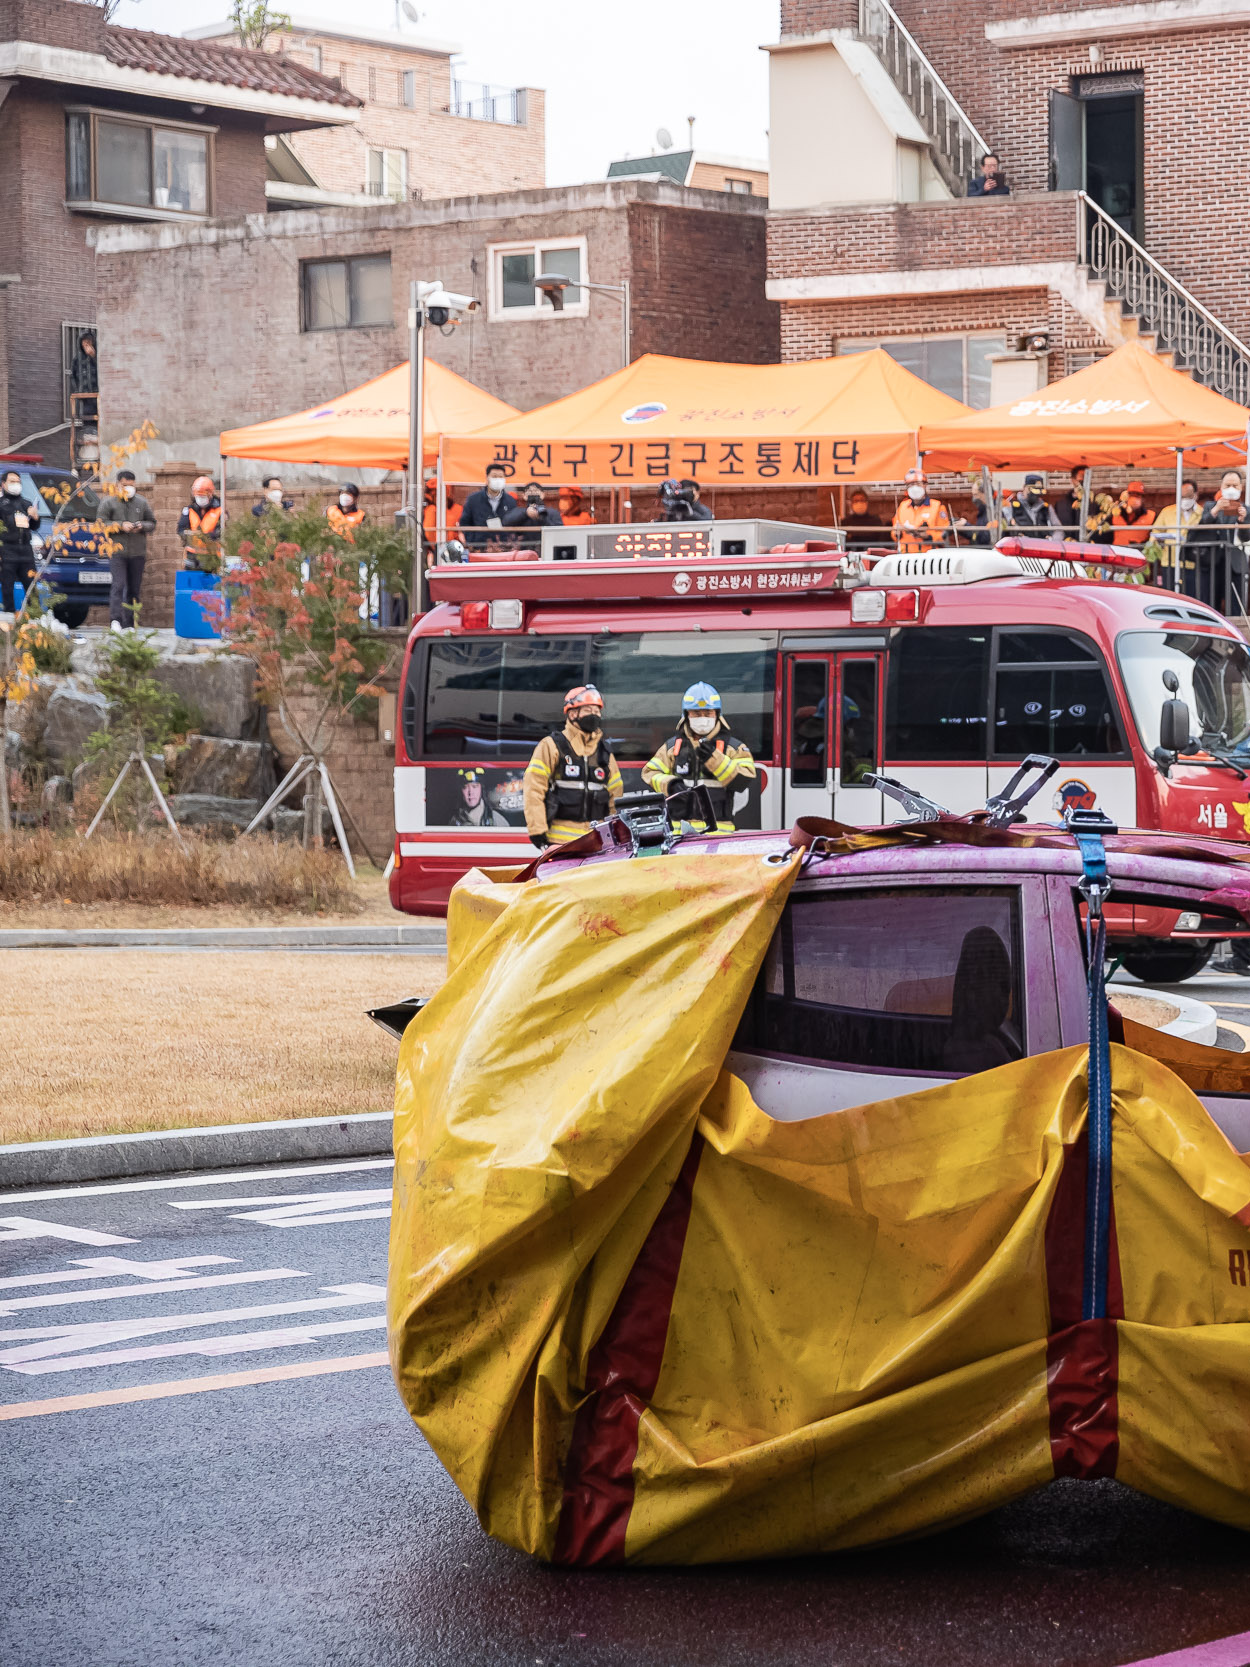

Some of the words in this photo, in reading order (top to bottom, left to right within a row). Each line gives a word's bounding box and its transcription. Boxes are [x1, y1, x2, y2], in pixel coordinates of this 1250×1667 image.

[492, 443, 588, 478] 광진구
[609, 440, 860, 478] 긴급구조통제단
[696, 574, 753, 591] 광진소방서
[756, 572, 824, 589] 현장지휘본부
[1197, 802, 1228, 829] 서울
